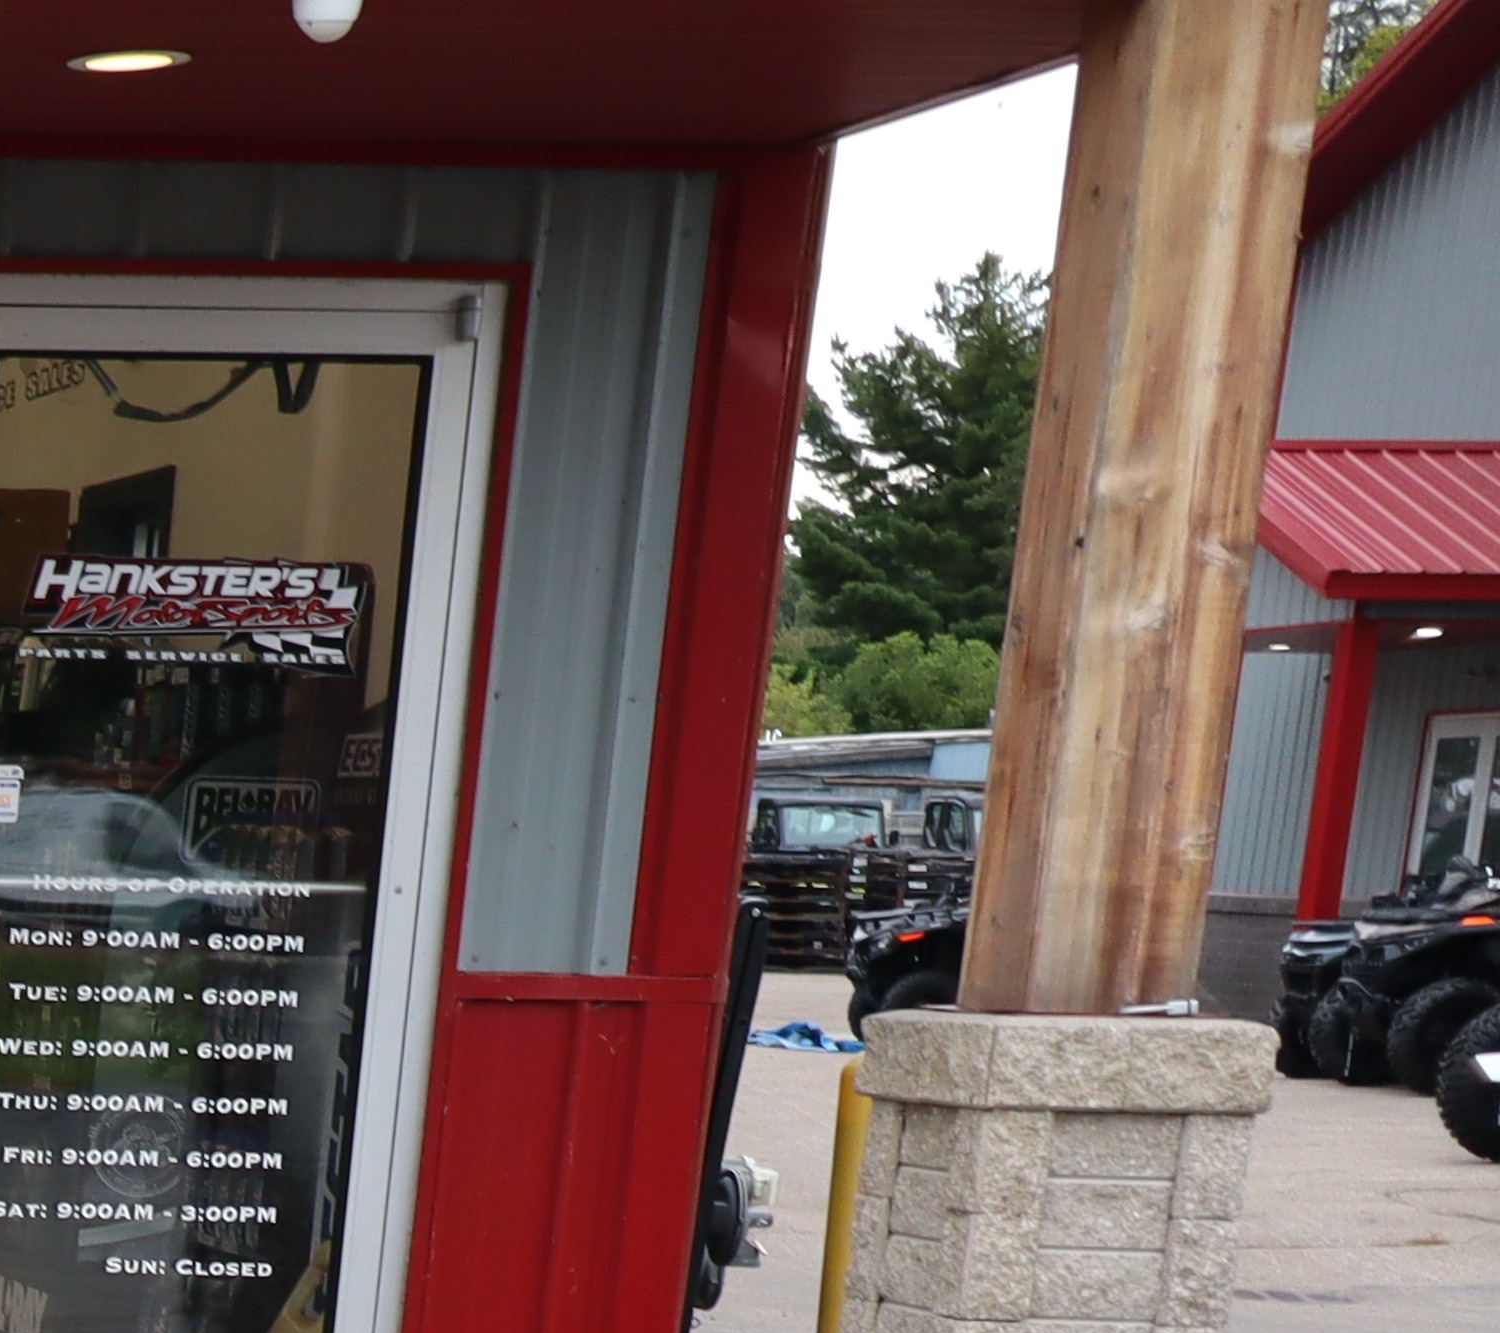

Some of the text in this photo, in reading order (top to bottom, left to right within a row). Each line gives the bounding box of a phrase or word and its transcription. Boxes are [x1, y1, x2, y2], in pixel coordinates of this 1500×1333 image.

[19, 647, 107, 660] PARTS
[125, 649, 245, 663] SERVICE
[9, 927, 73, 947] MON:
[207, 933, 305, 953] 6:00PM
[9, 982, 68, 1002] TUE:
[76, 983, 175, 1004] 9:00AM
[202, 988, 299, 1008] 6:00PM
[71, 1038, 169, 1059] 9:00AM
[196, 1042, 294, 1062] 6:00PM
[66, 1094, 164, 1113] 9:00AM
[191, 1096, 288, 1116] 6:00PM
[2, 1146, 53, 1165] FRI:
[60, 1148, 159, 1167] 9:00AM
[185, 1151, 283, 1170] 6:00PM
[56, 1202, 154, 1221] 9:00AM
[180, 1205, 278, 1224] 3:00PM
[105, 1256, 274, 1278] SUN: CLOSED
